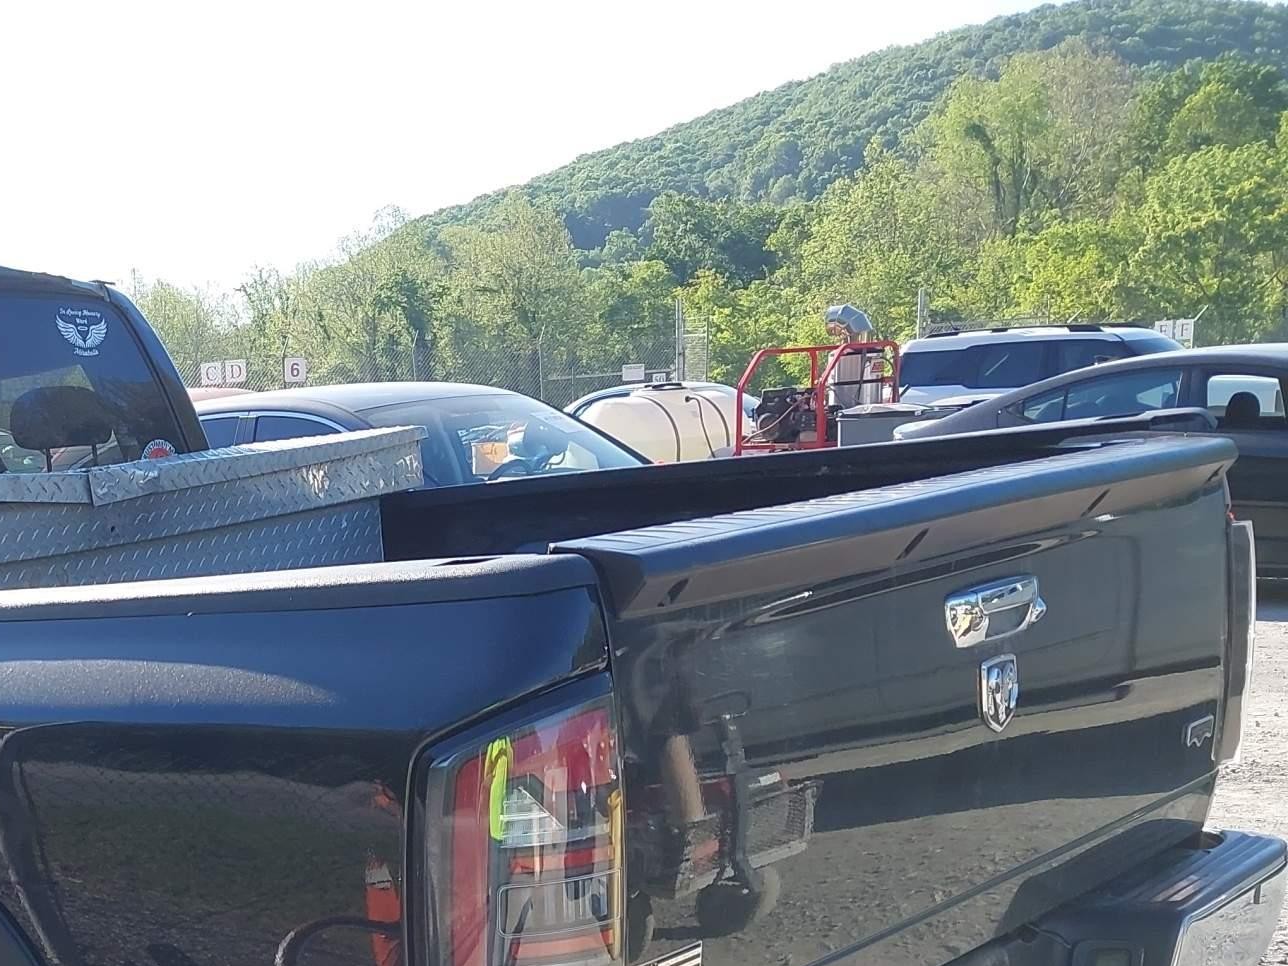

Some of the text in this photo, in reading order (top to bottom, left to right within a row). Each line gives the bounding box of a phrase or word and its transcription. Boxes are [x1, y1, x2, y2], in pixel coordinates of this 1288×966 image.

[205, 365, 218, 382] C
[230, 363, 243, 380] D
[290, 362, 300, 378] 6
